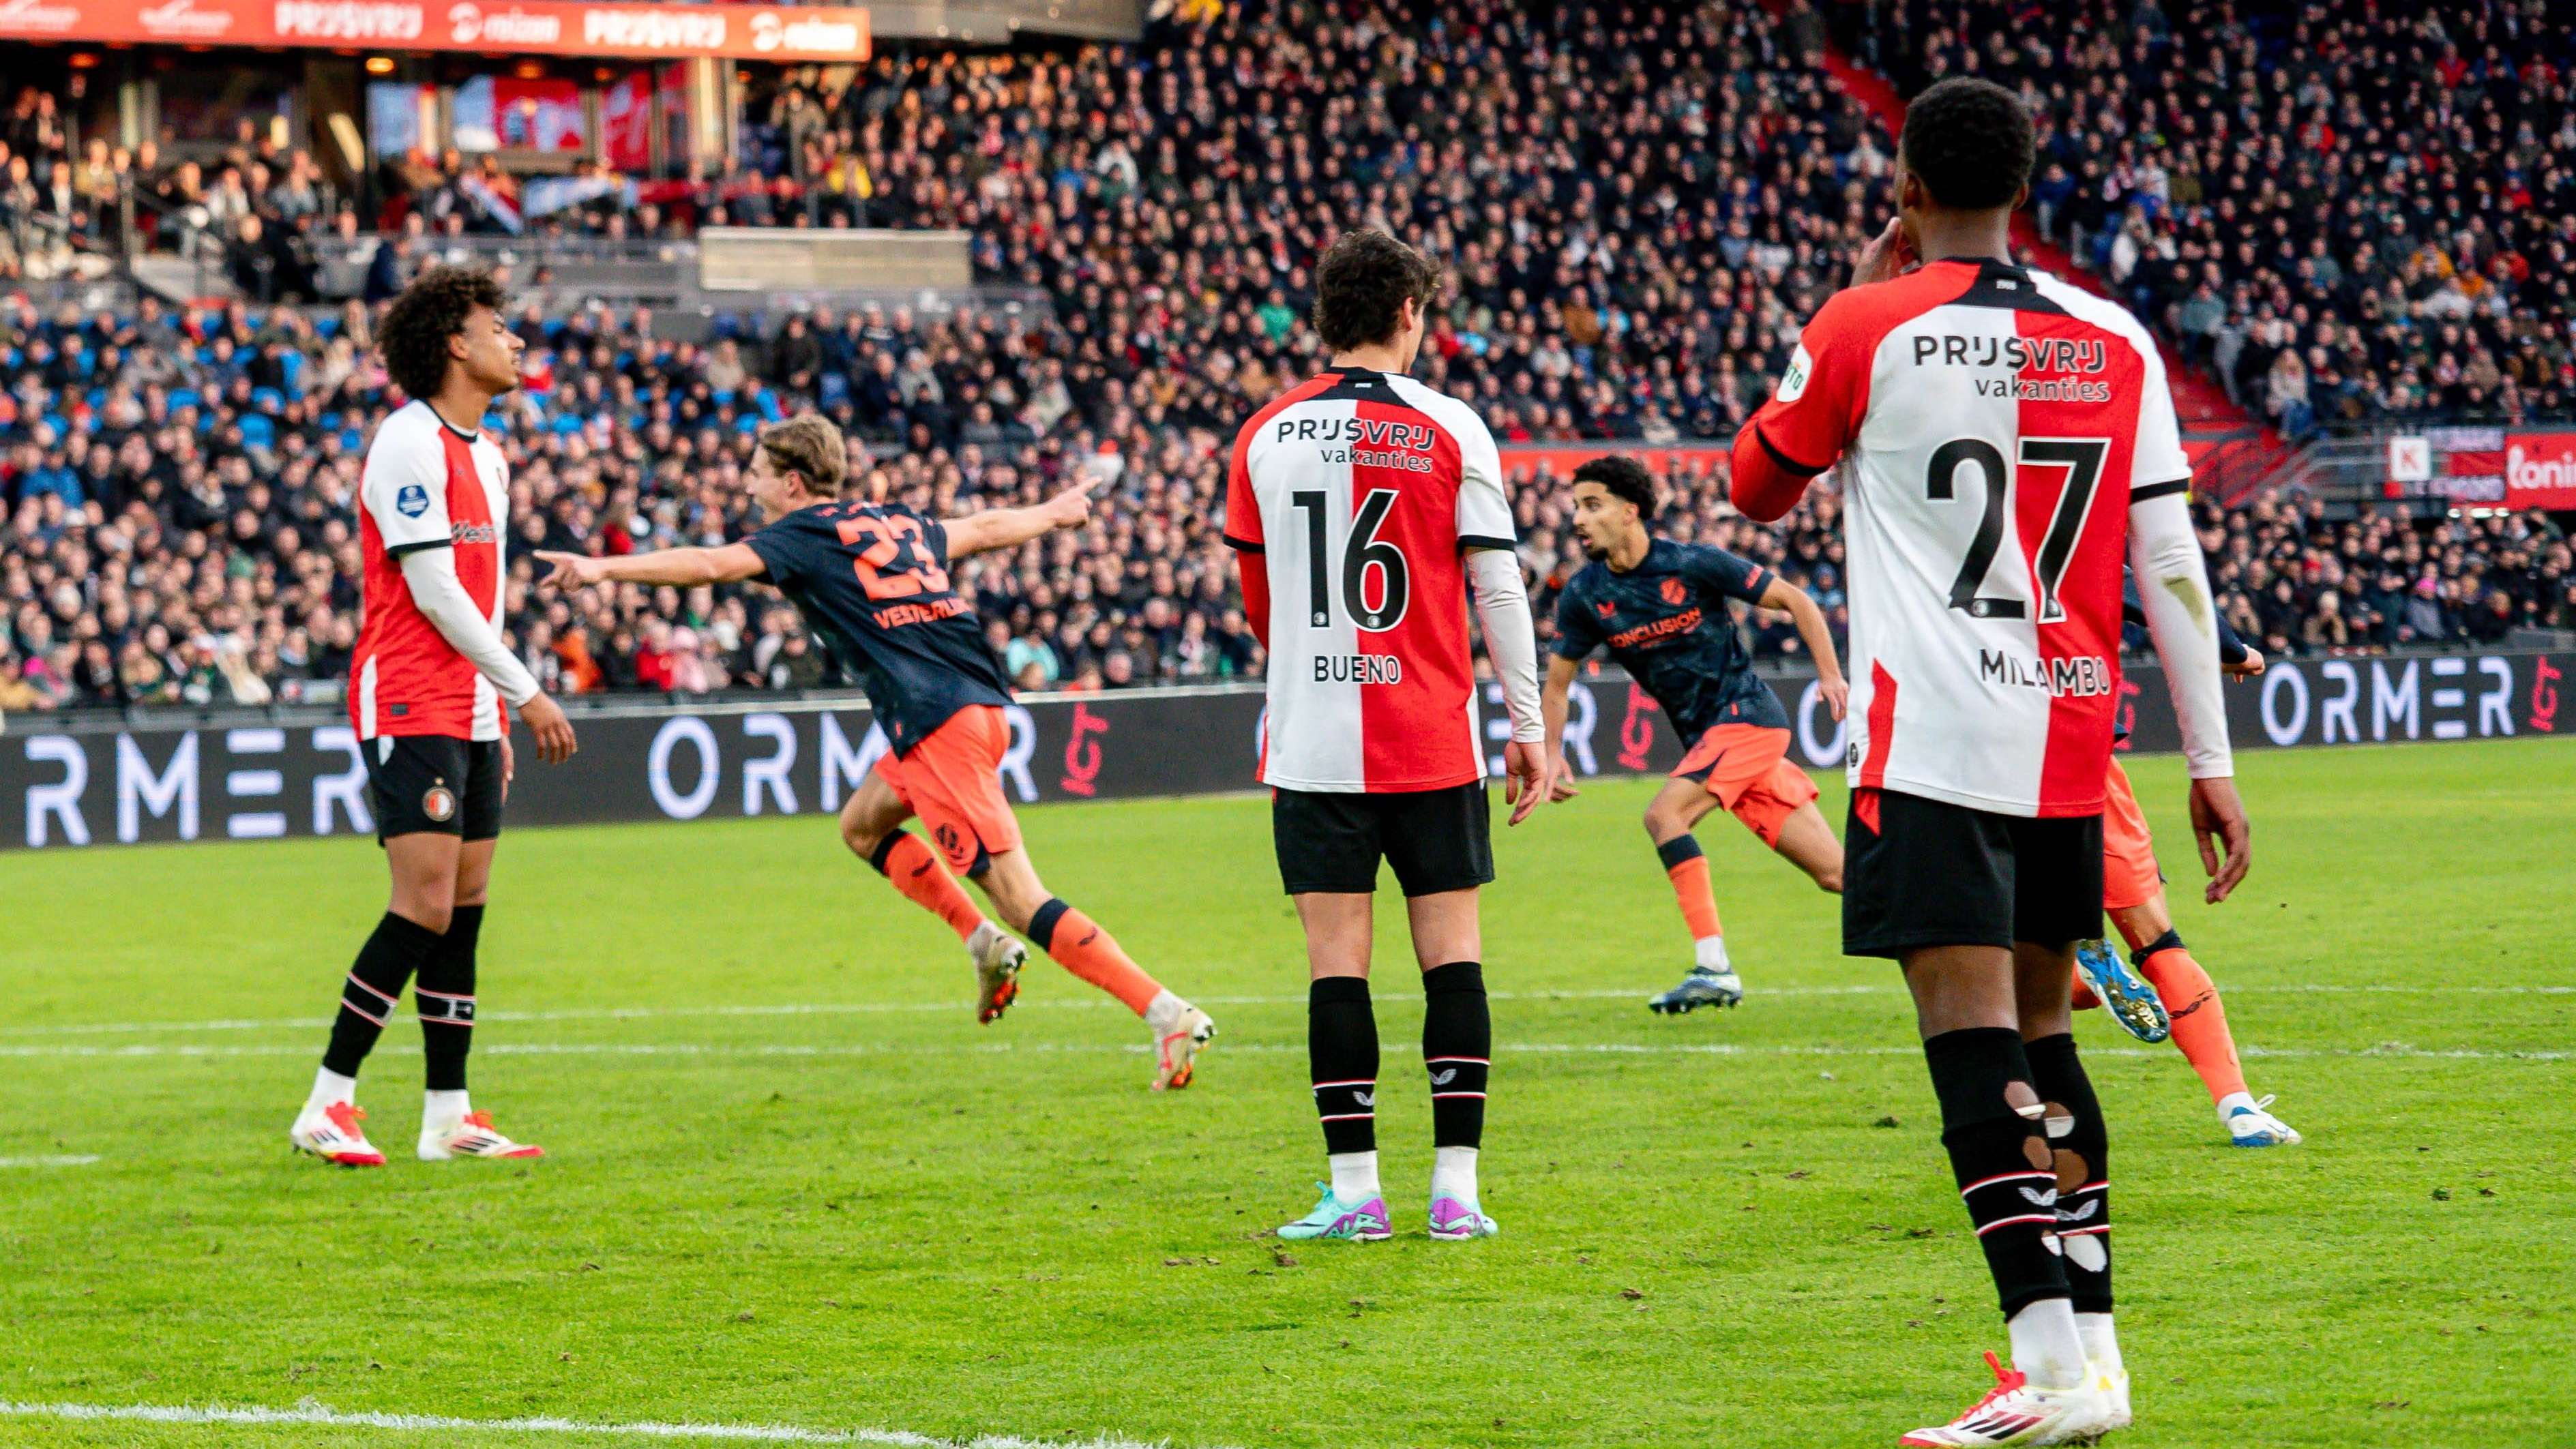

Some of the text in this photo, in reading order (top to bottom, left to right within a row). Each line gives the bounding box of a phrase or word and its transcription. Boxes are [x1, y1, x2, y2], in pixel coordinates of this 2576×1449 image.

[1912, 335, 2107, 373] PRIJSVRIJ
[1975, 375, 2111, 402] vakanties
[1277, 418, 1435, 451] PRIJSVRIJ
[1321, 445, 1434, 473] vakanties
[1924, 436, 2113, 624] 27
[835, 514, 949, 601] 23
[1292, 489, 1409, 633] 16
[1314, 655, 1402, 685] BUENO
[1981, 649, 2112, 698] MILAMBO
[2260, 656, 2516, 747] ORMER
[647, 704, 1039, 820] ORMR
